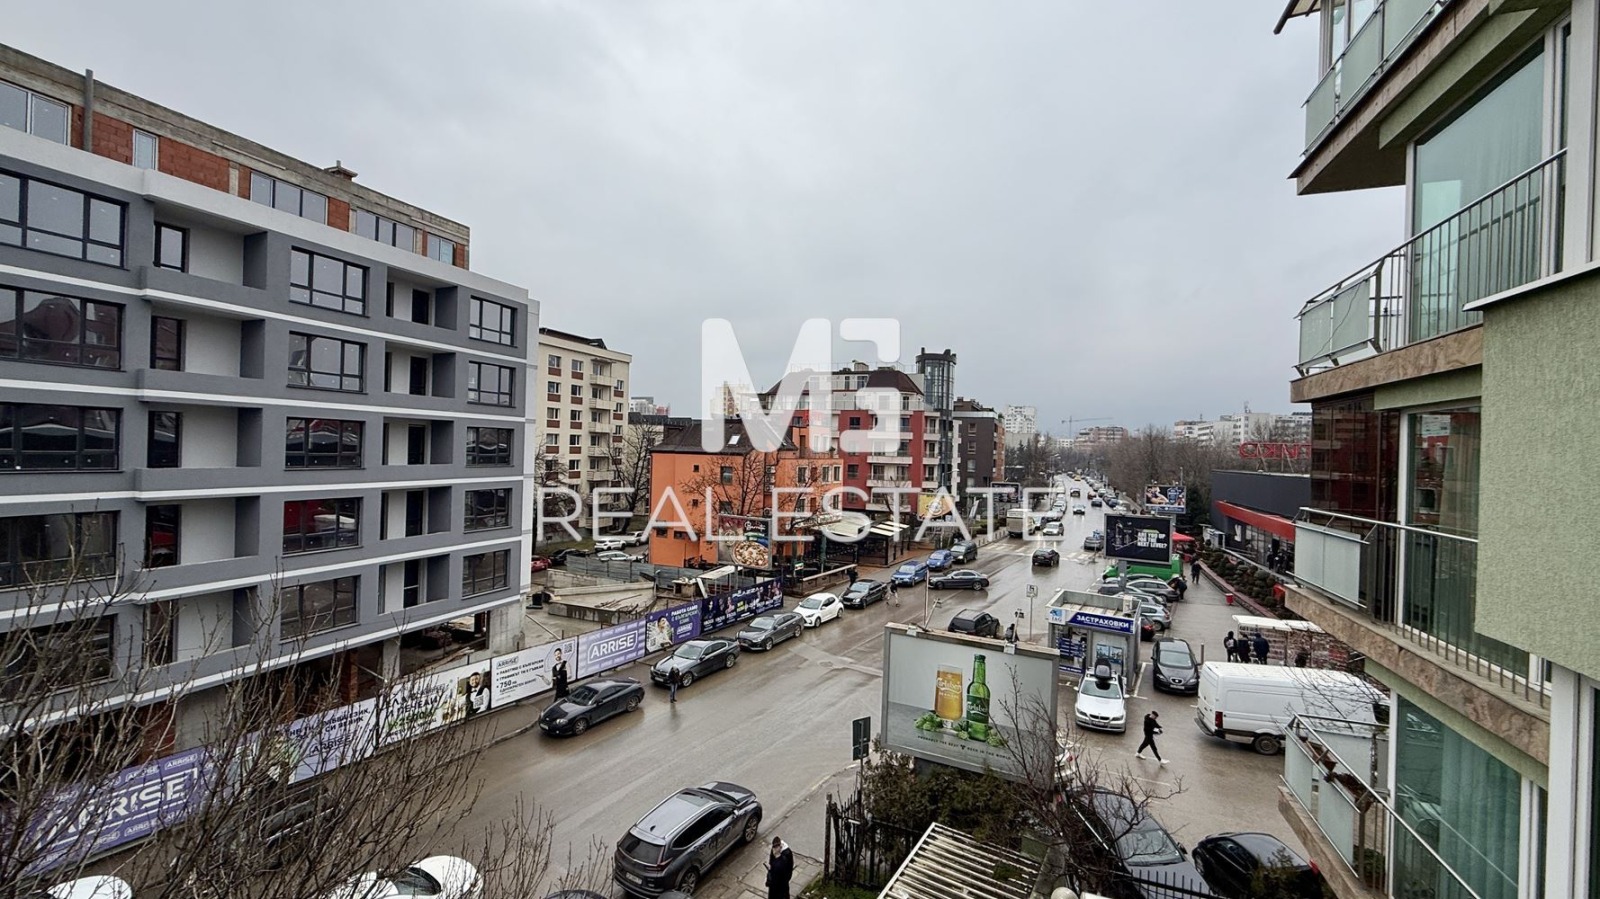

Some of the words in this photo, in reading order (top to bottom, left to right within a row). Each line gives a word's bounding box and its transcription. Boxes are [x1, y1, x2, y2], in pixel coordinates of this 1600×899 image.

[1076, 615, 1129, 628] ЗАСТРАХОВКИ
[590, 635, 634, 659] ARRISE
[500, 680, 512, 688] 750
